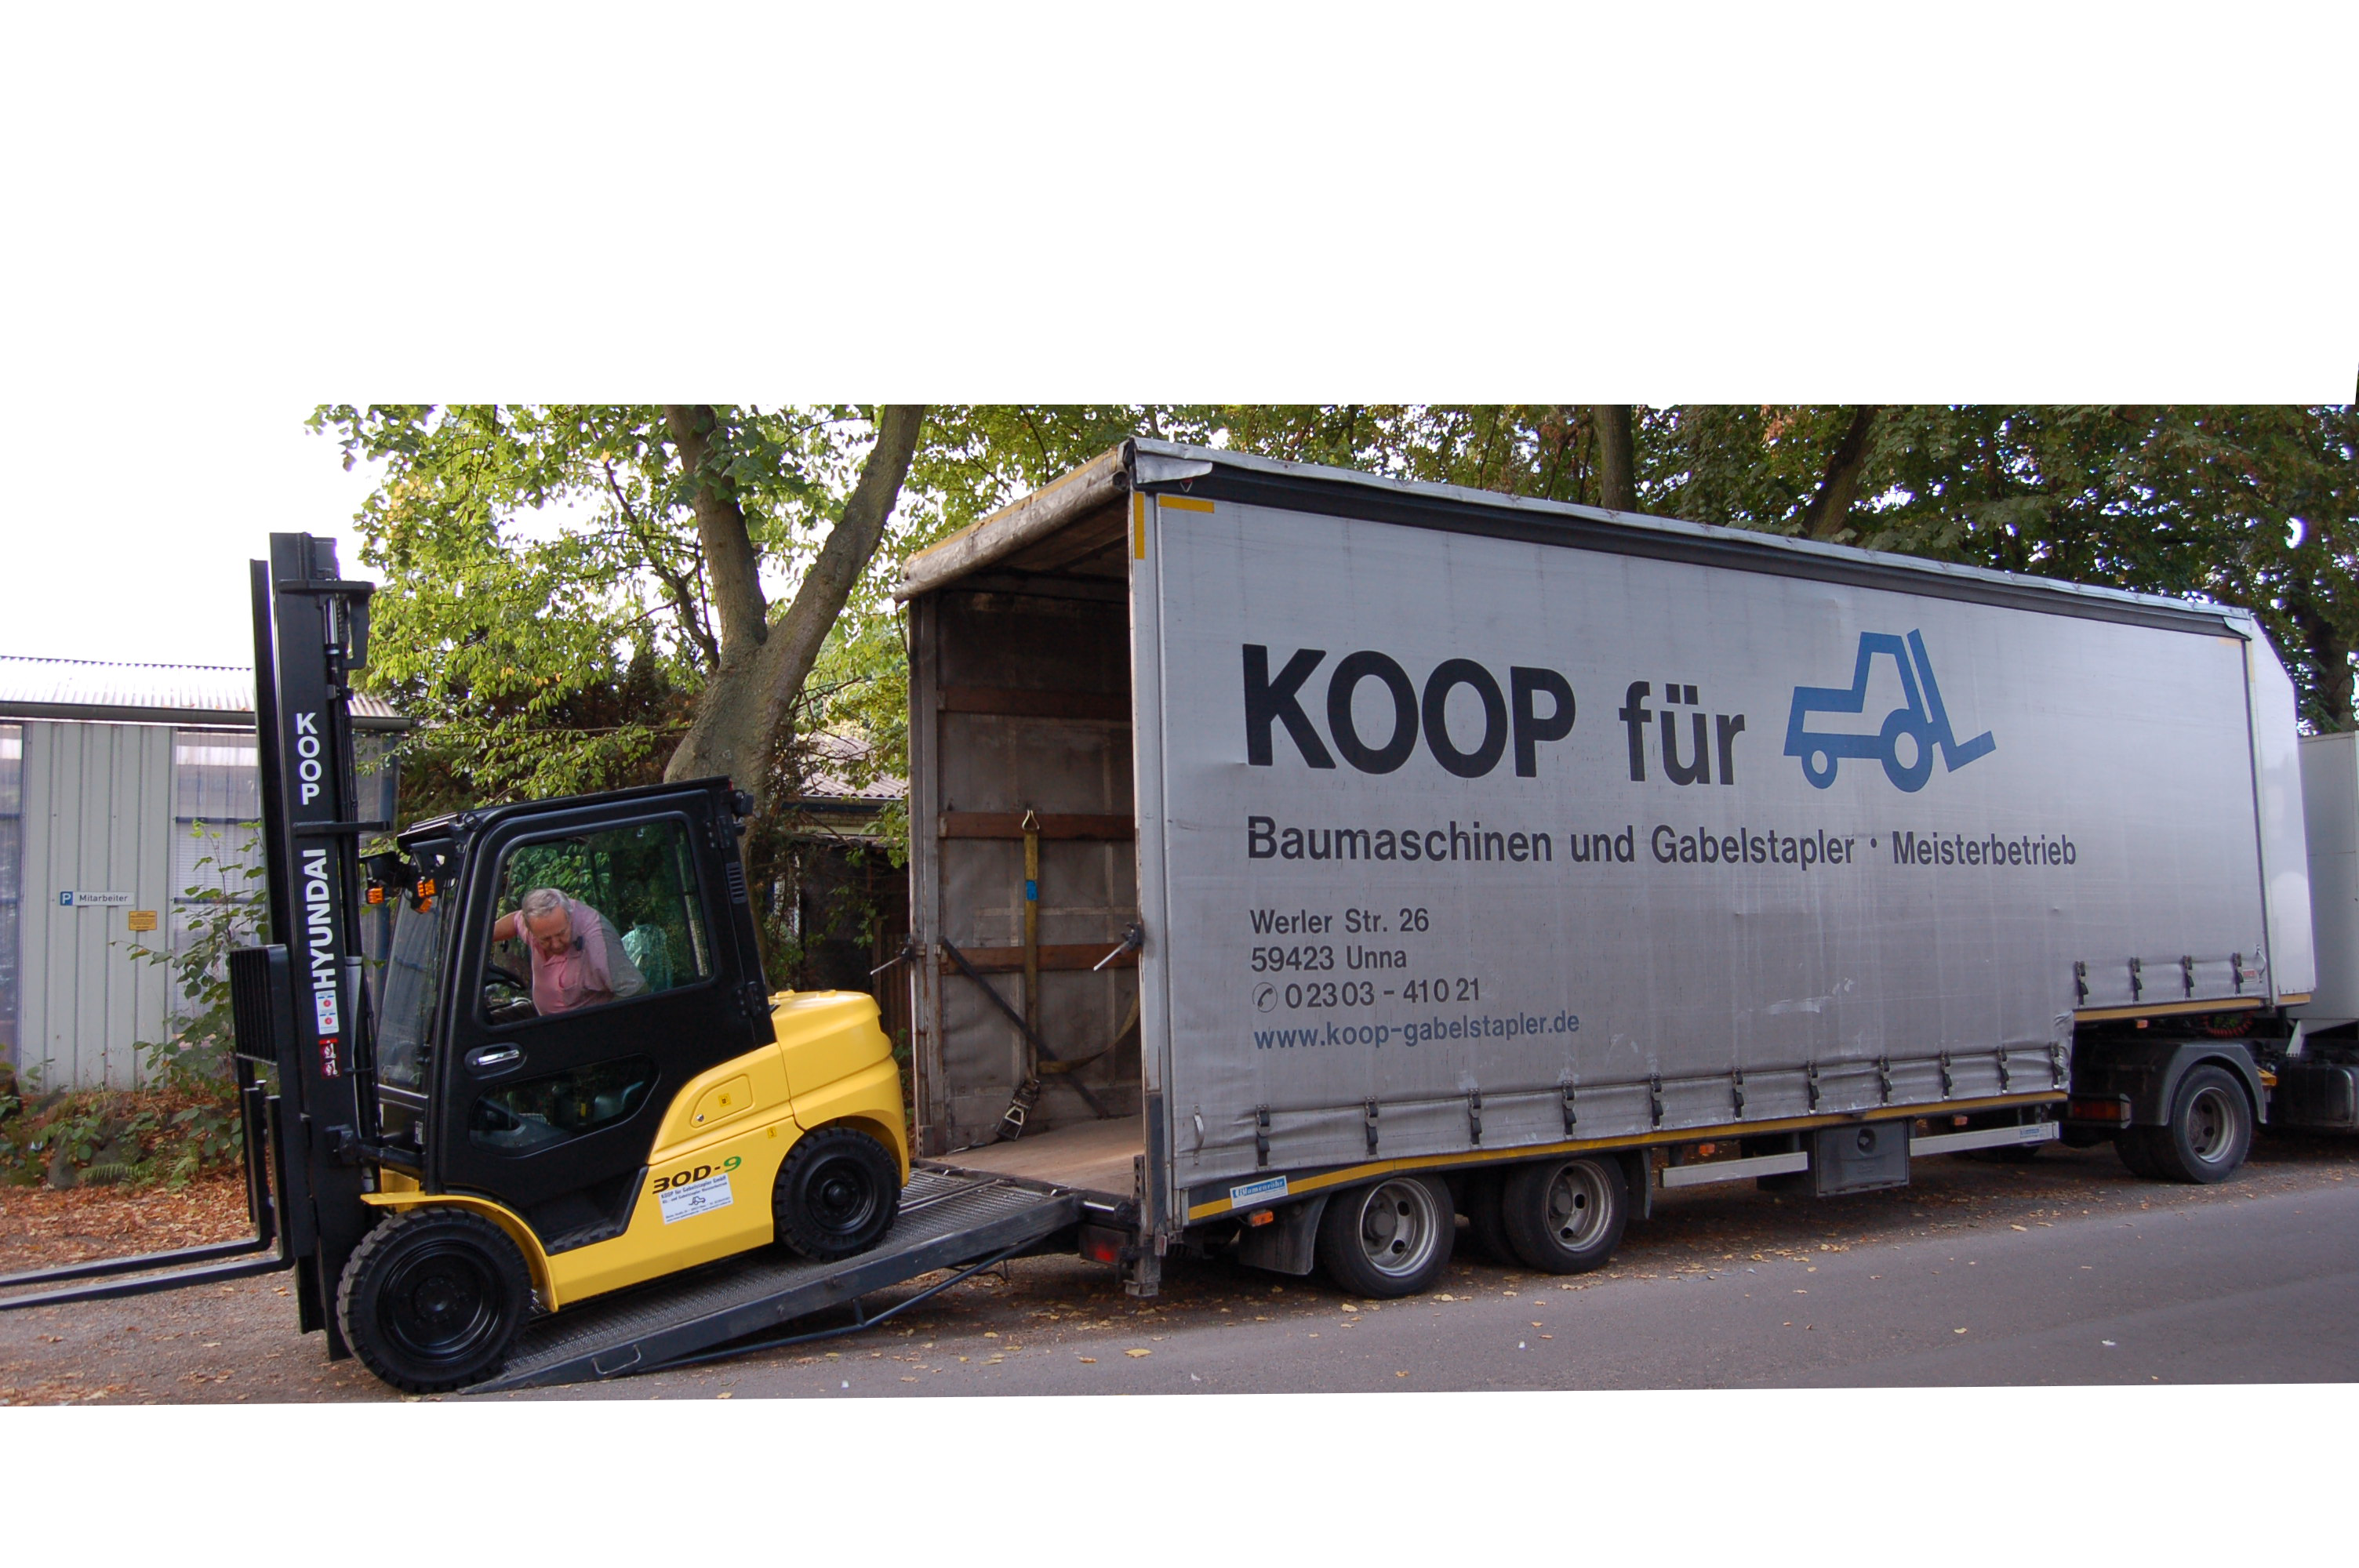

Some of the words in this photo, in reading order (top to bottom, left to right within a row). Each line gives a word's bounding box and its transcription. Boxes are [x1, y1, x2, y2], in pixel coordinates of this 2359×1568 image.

[1242, 644, 1576, 779] KOOP
[1619, 681, 1746, 786] für
[296, 712, 322, 805] KOOP
[1248, 815, 1552, 862] Baumaschinen
[1571, 825, 1635, 863] und
[1651, 825, 1855, 871] Gabelstapler
[1892, 831, 2077, 866] Meisterbetrieb
[303, 849, 336, 990] HYUNDAI
[1250, 909, 1333, 935] Werler
[1345, 909, 1388, 934] Str.
[1400, 908, 1430, 932] 26
[1251, 946, 1335, 973] 59423
[1347, 946, 1407, 970] Unna
[1255, 1011, 1579, 1049] www.koop-gabelstapler.de
[652, 1156, 742, 1194] 30D-9
